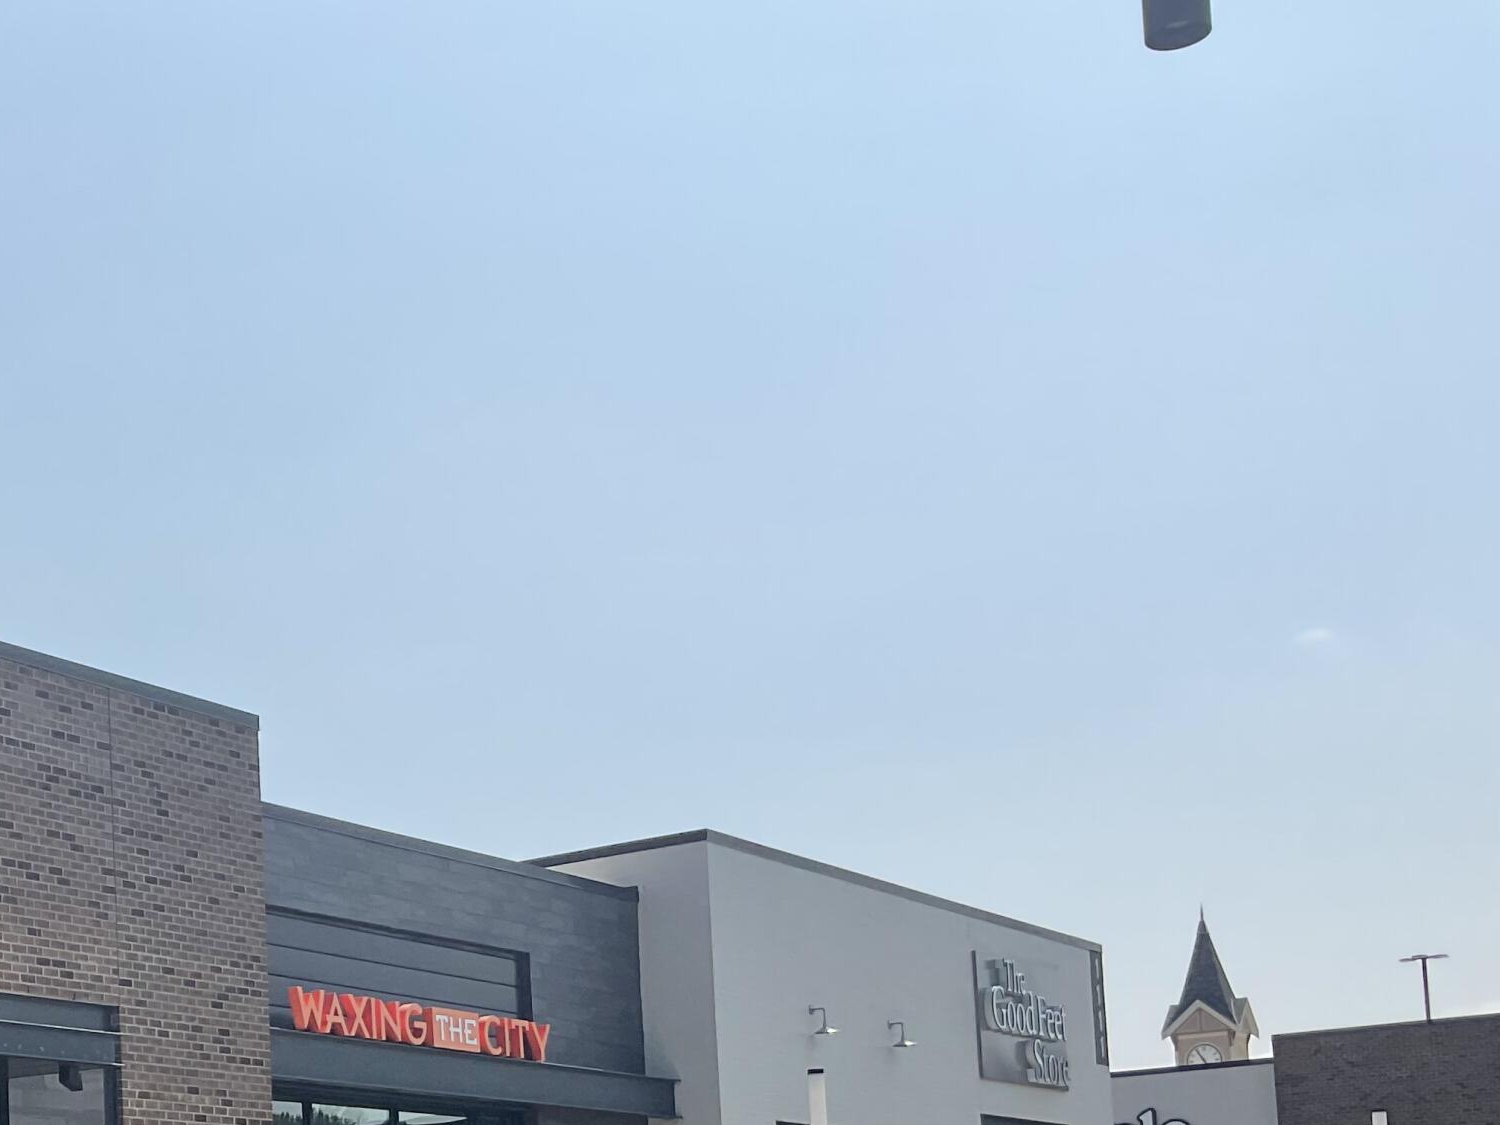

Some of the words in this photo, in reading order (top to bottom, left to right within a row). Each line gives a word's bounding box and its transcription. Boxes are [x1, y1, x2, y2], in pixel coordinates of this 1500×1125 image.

[1003, 958, 1027, 996] The
[288, 986, 427, 1046] WAXING
[435, 1014, 477, 1046] THE
[479, 1015, 550, 1063] CITY
[991, 985, 1037, 1036] Good
[1037, 994, 1067, 1041] Feet
[1033, 1038, 1070, 1087] Store
